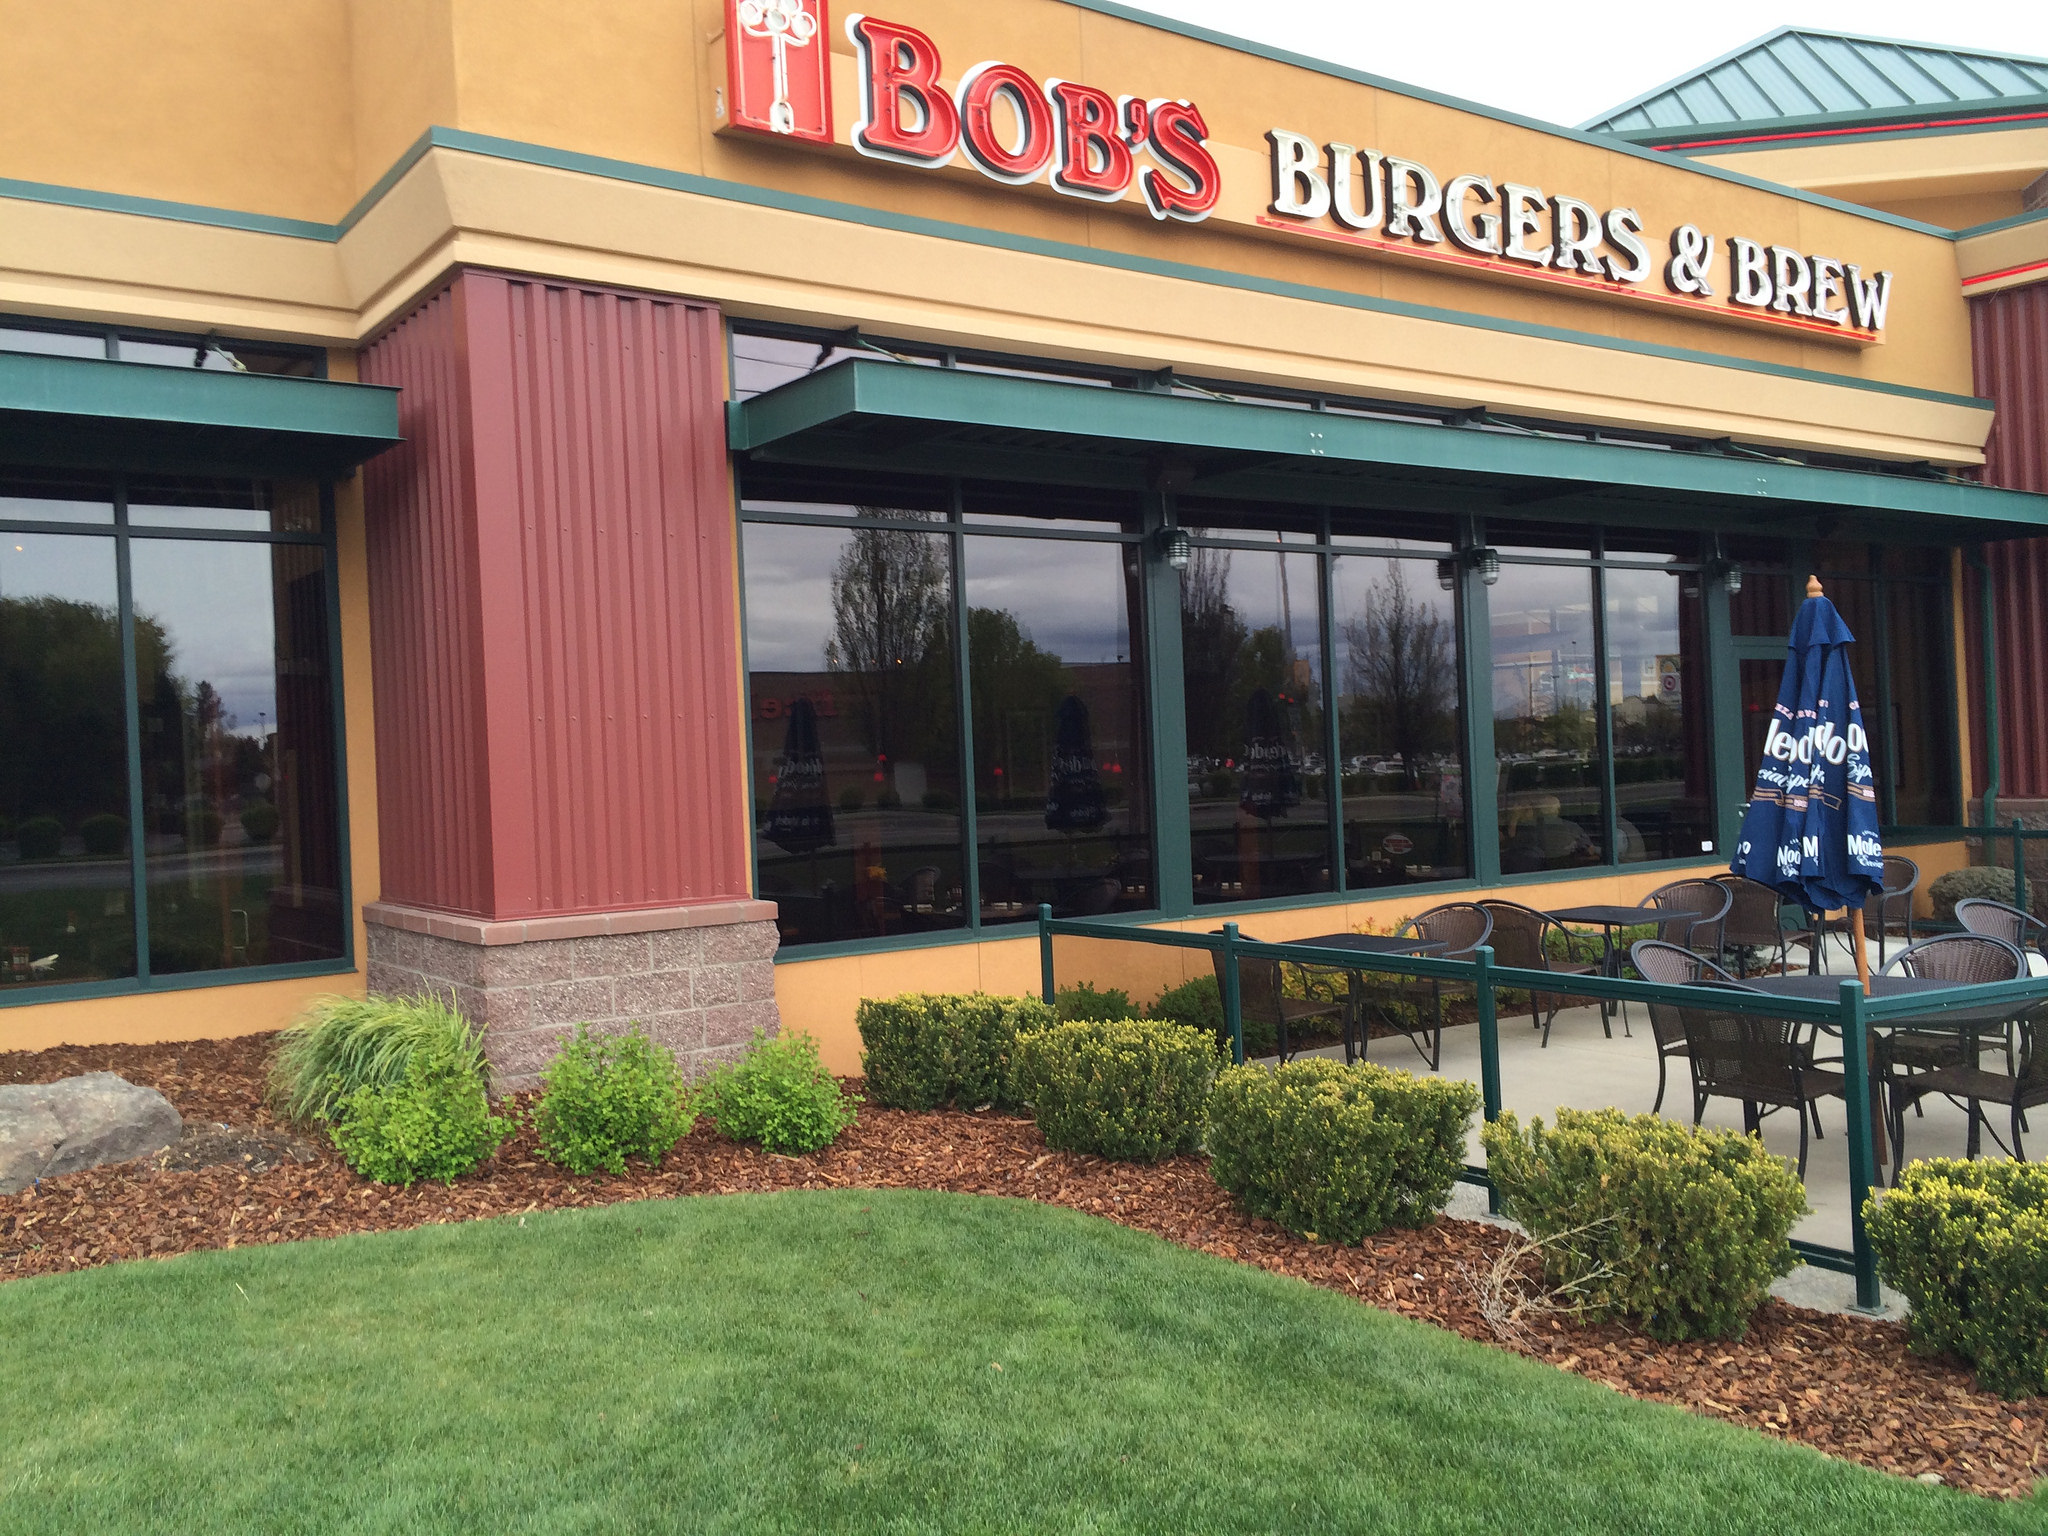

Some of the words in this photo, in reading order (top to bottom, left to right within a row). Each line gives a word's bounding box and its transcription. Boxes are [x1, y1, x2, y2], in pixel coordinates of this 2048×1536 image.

[850, 14, 1222, 219] BOB'S
[1264, 127, 1652, 284] BURGERS
[1665, 222, 1715, 298] &
[1726, 236, 1893, 331] BREW
